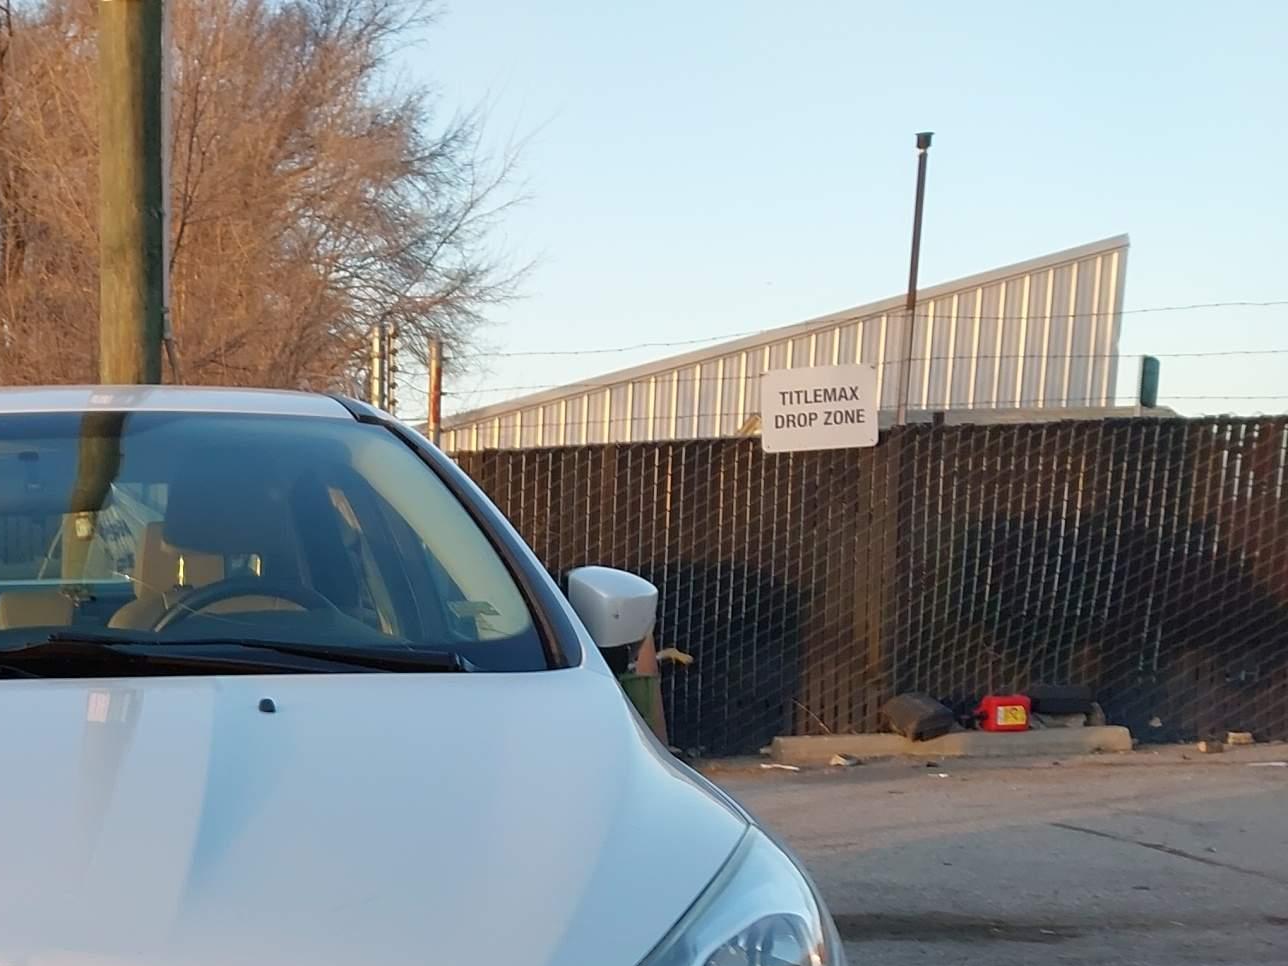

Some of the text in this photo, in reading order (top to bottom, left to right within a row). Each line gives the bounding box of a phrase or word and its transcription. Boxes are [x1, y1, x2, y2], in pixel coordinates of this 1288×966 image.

[778, 386, 860, 406] TITLEMAX
[774, 409, 865, 429] DROP ZONE
